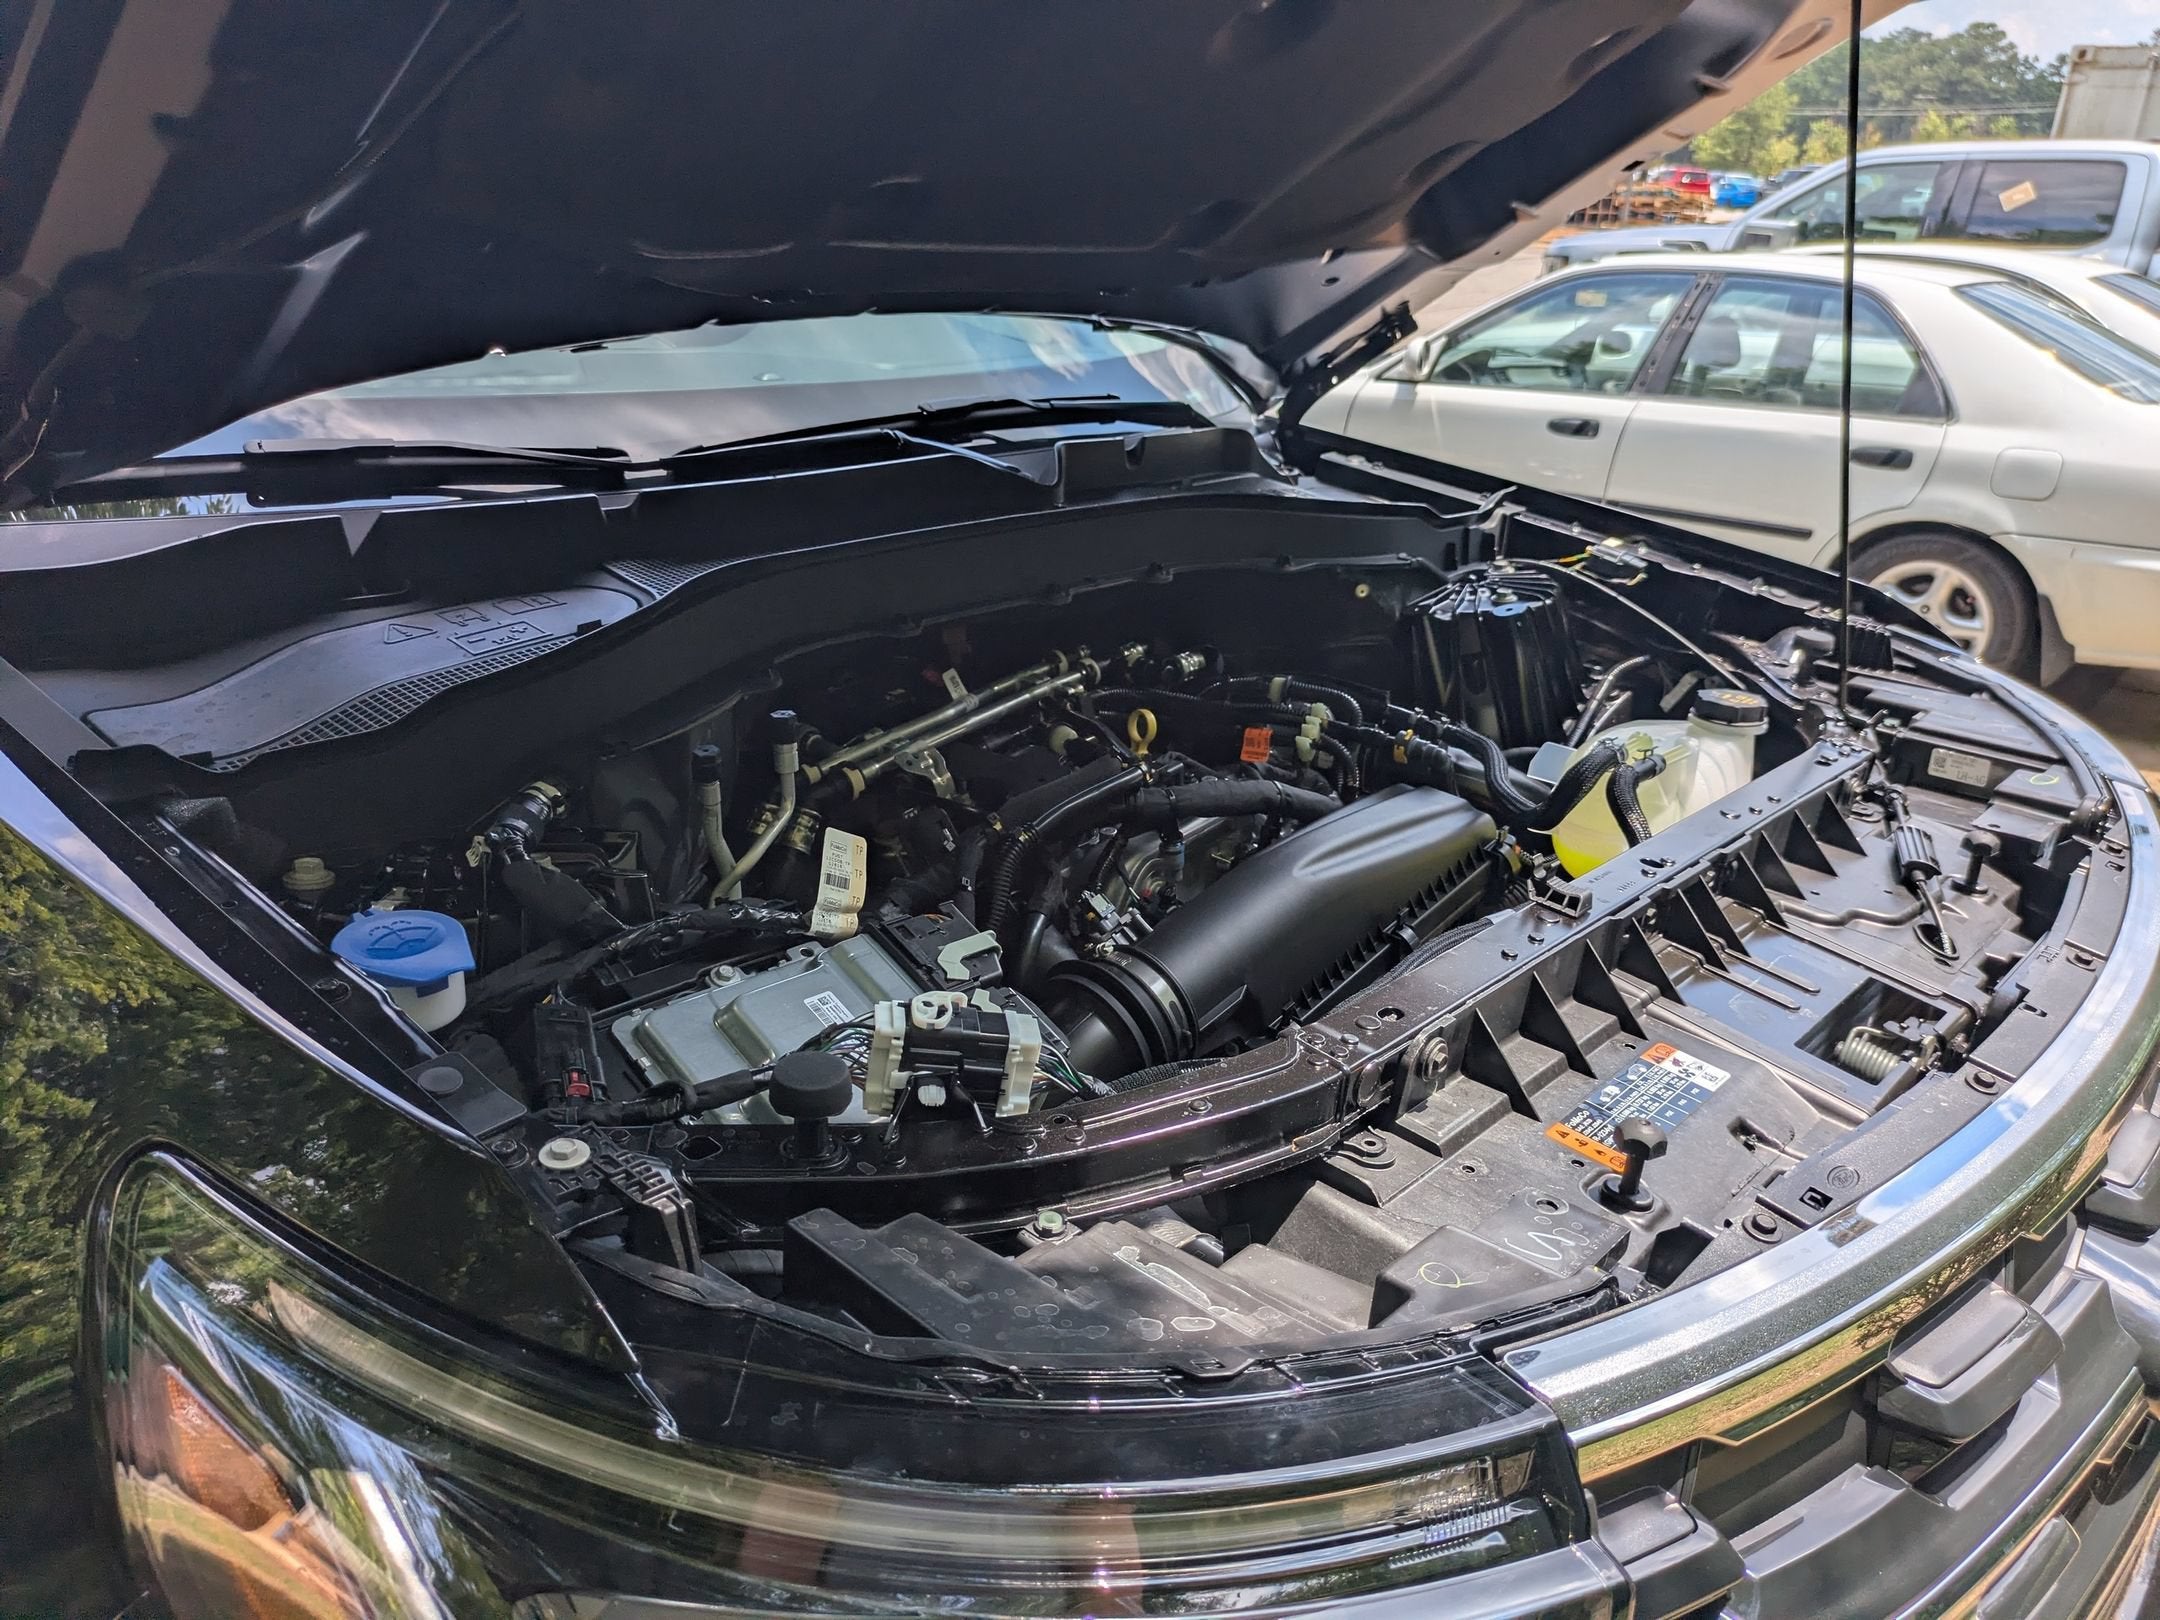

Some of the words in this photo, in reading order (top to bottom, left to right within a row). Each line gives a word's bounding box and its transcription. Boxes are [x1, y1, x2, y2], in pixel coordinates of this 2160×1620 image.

[491, 635, 520, 645] 12V
[856, 844, 864, 856] TP
[855, 869, 863, 879] TP
[852, 895, 861, 906] TP
[1565, 1110, 1590, 1129] FoMoCo
